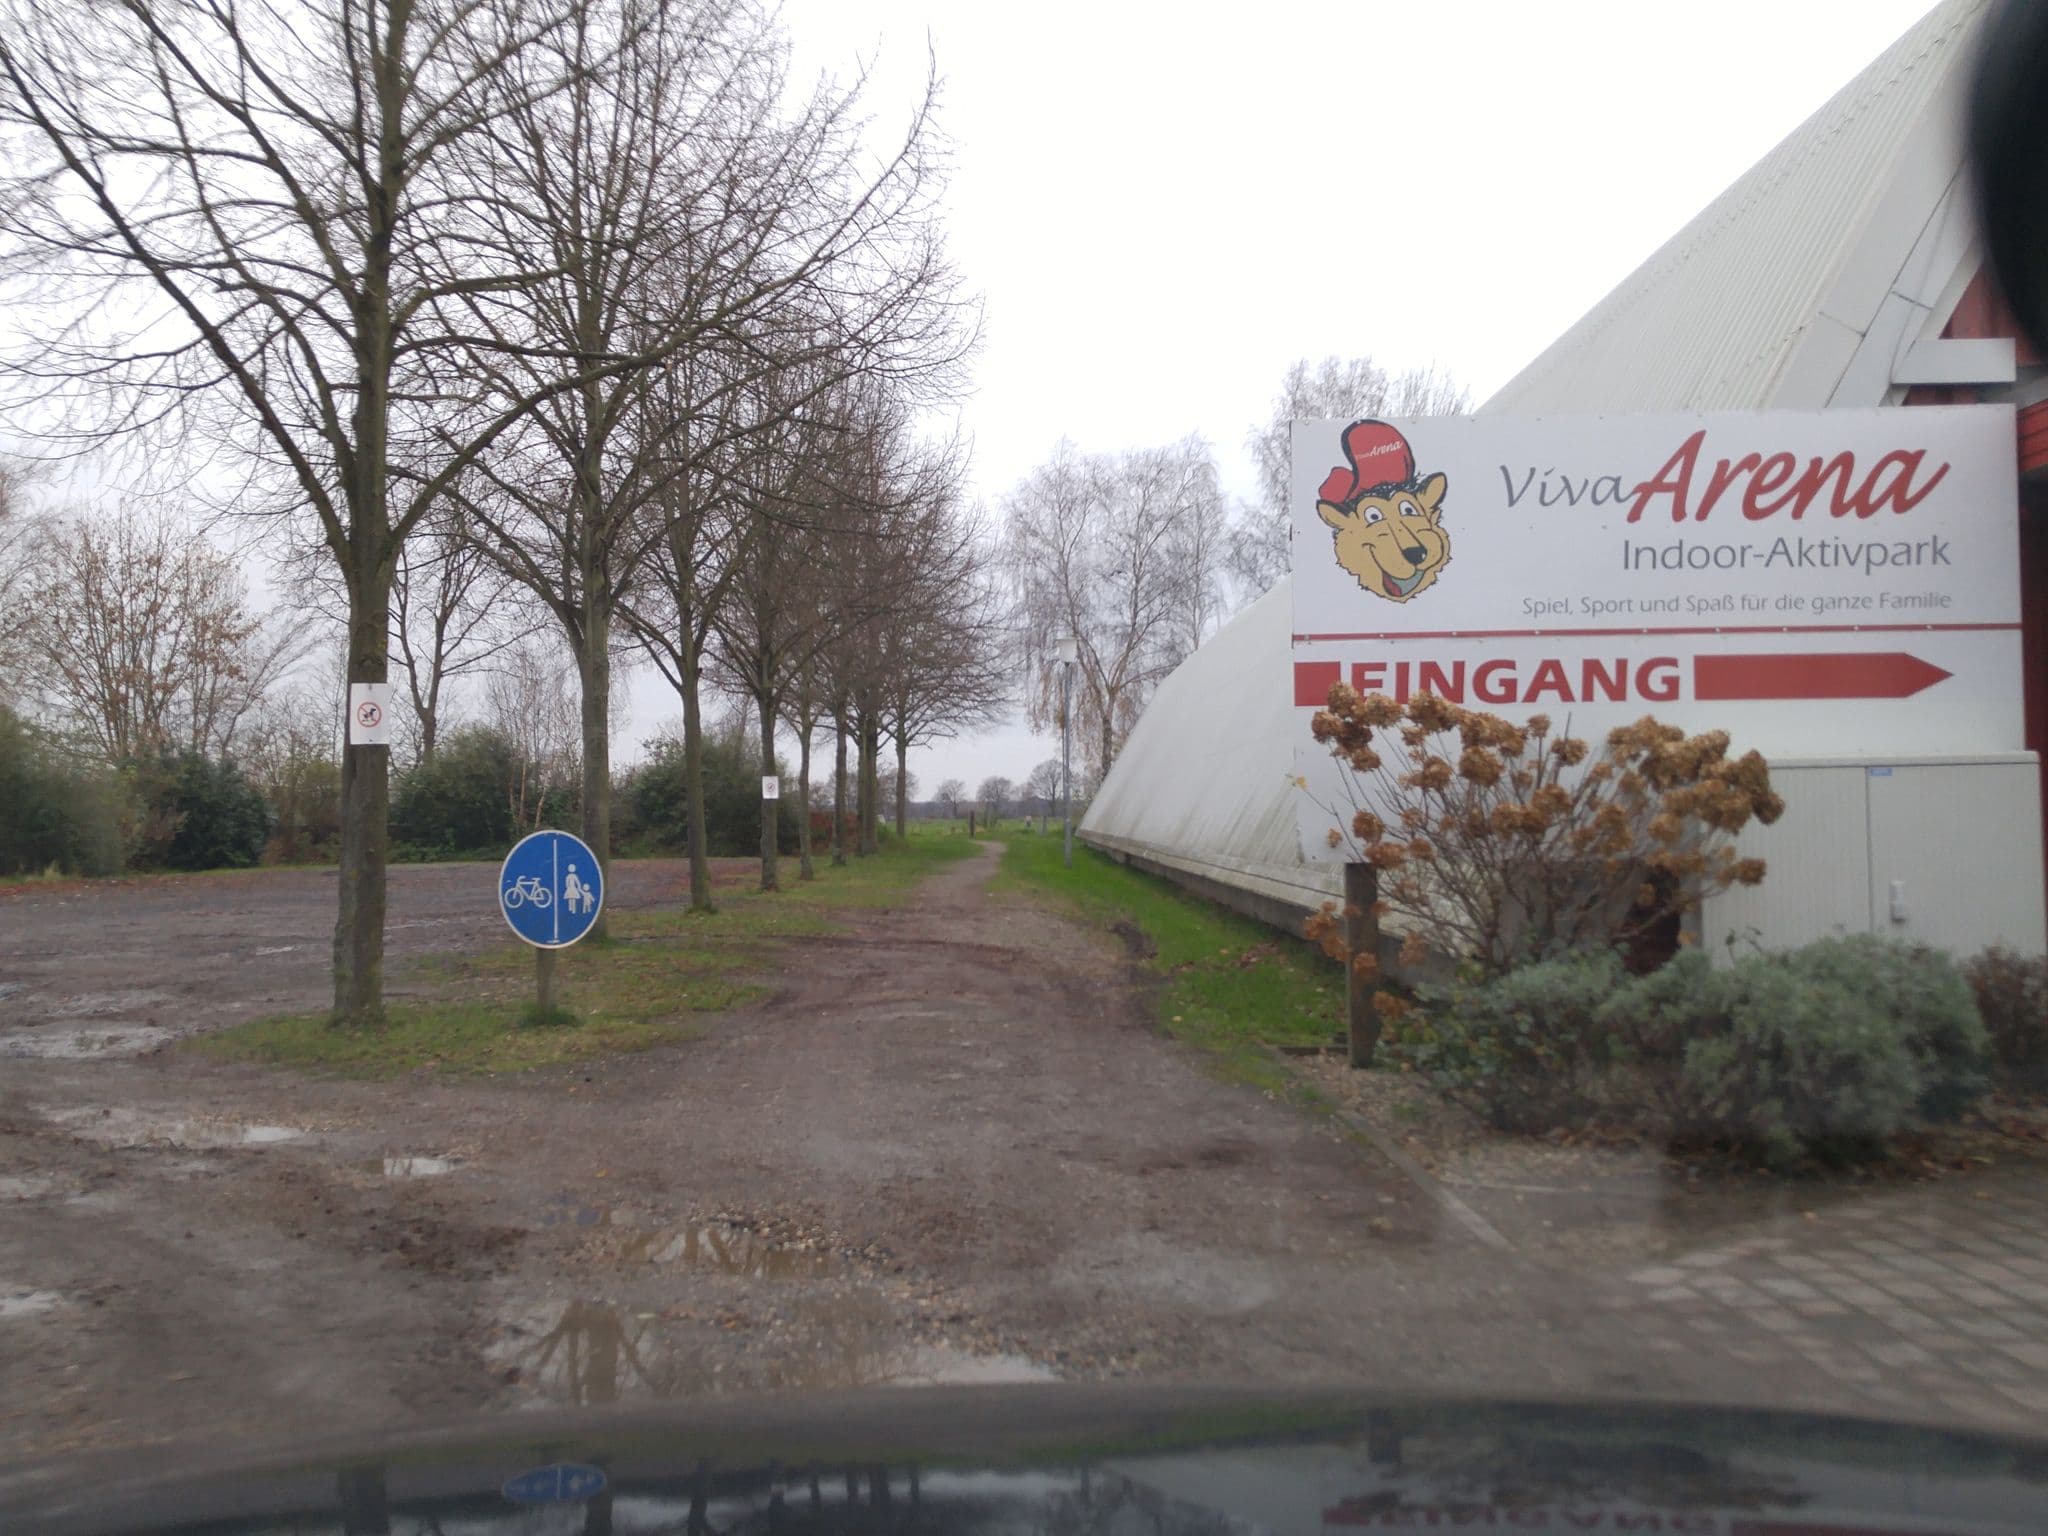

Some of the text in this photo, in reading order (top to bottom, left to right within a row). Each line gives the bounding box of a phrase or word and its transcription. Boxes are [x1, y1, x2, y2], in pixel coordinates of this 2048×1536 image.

[1623, 535, 1951, 576] Indoor-Aktivpark
[1522, 591, 1952, 618] Spiel, Sport und Spaß für die ganze Familie
[1352, 656, 1680, 703] EINGANG
